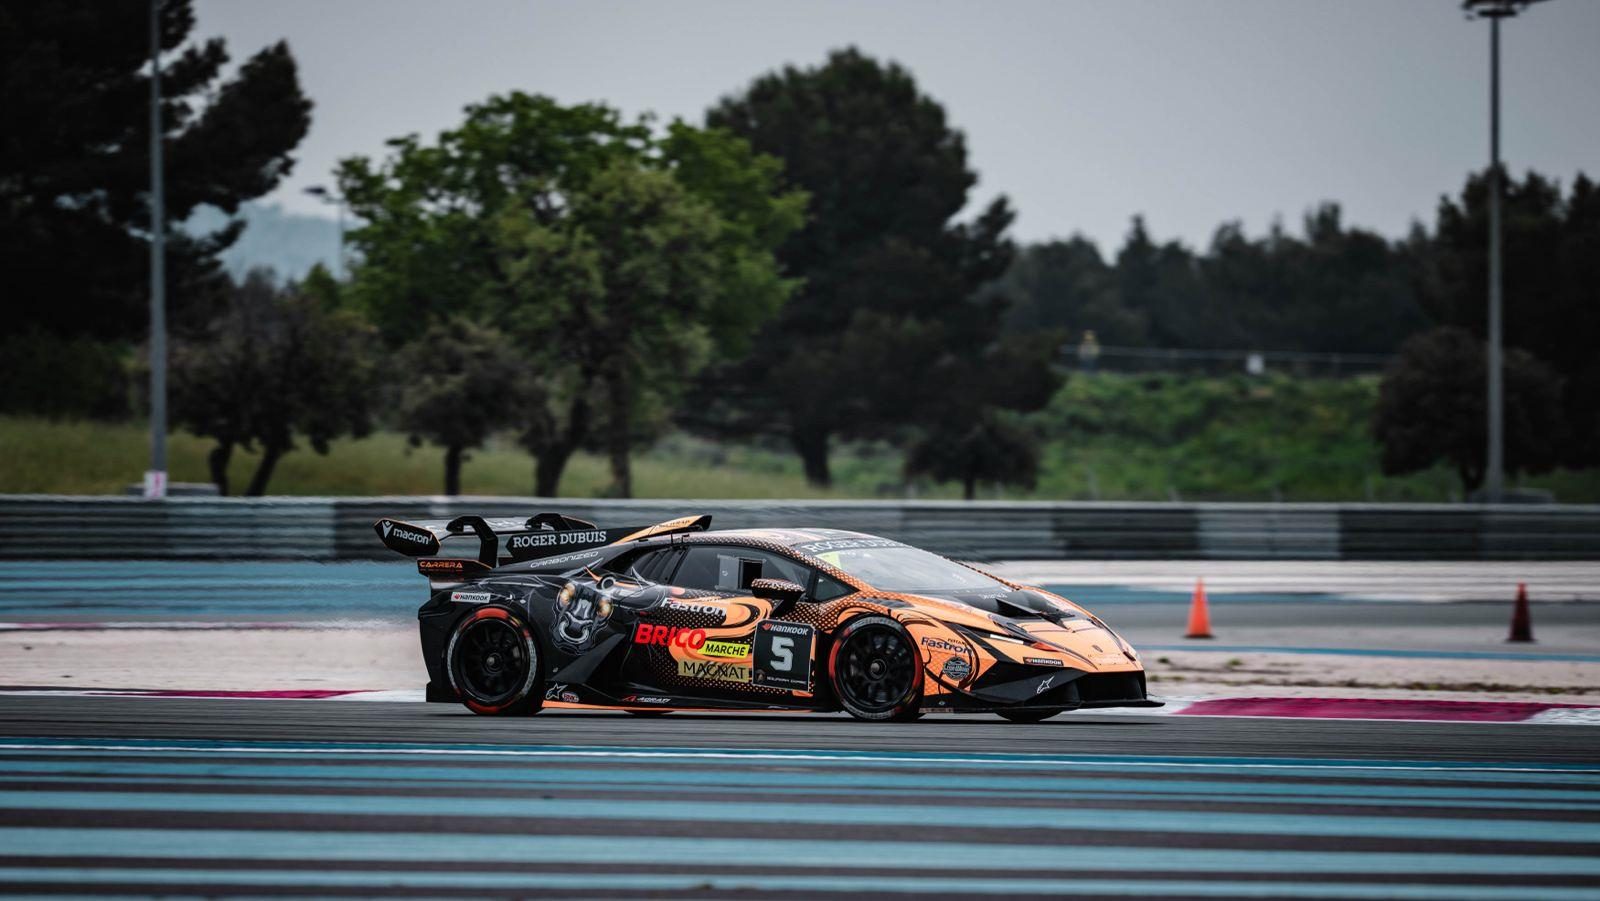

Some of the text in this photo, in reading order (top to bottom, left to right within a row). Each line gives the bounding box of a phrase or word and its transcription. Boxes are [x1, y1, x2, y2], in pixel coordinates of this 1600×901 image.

[393, 527, 433, 544] macron
[512, 531, 607, 548] ROGER DUBUIS
[660, 598, 727, 616] Fastron
[635, 623, 707, 650] BRICO
[921, 636, 971, 655] Fastron
[770, 636, 795, 671] 5
